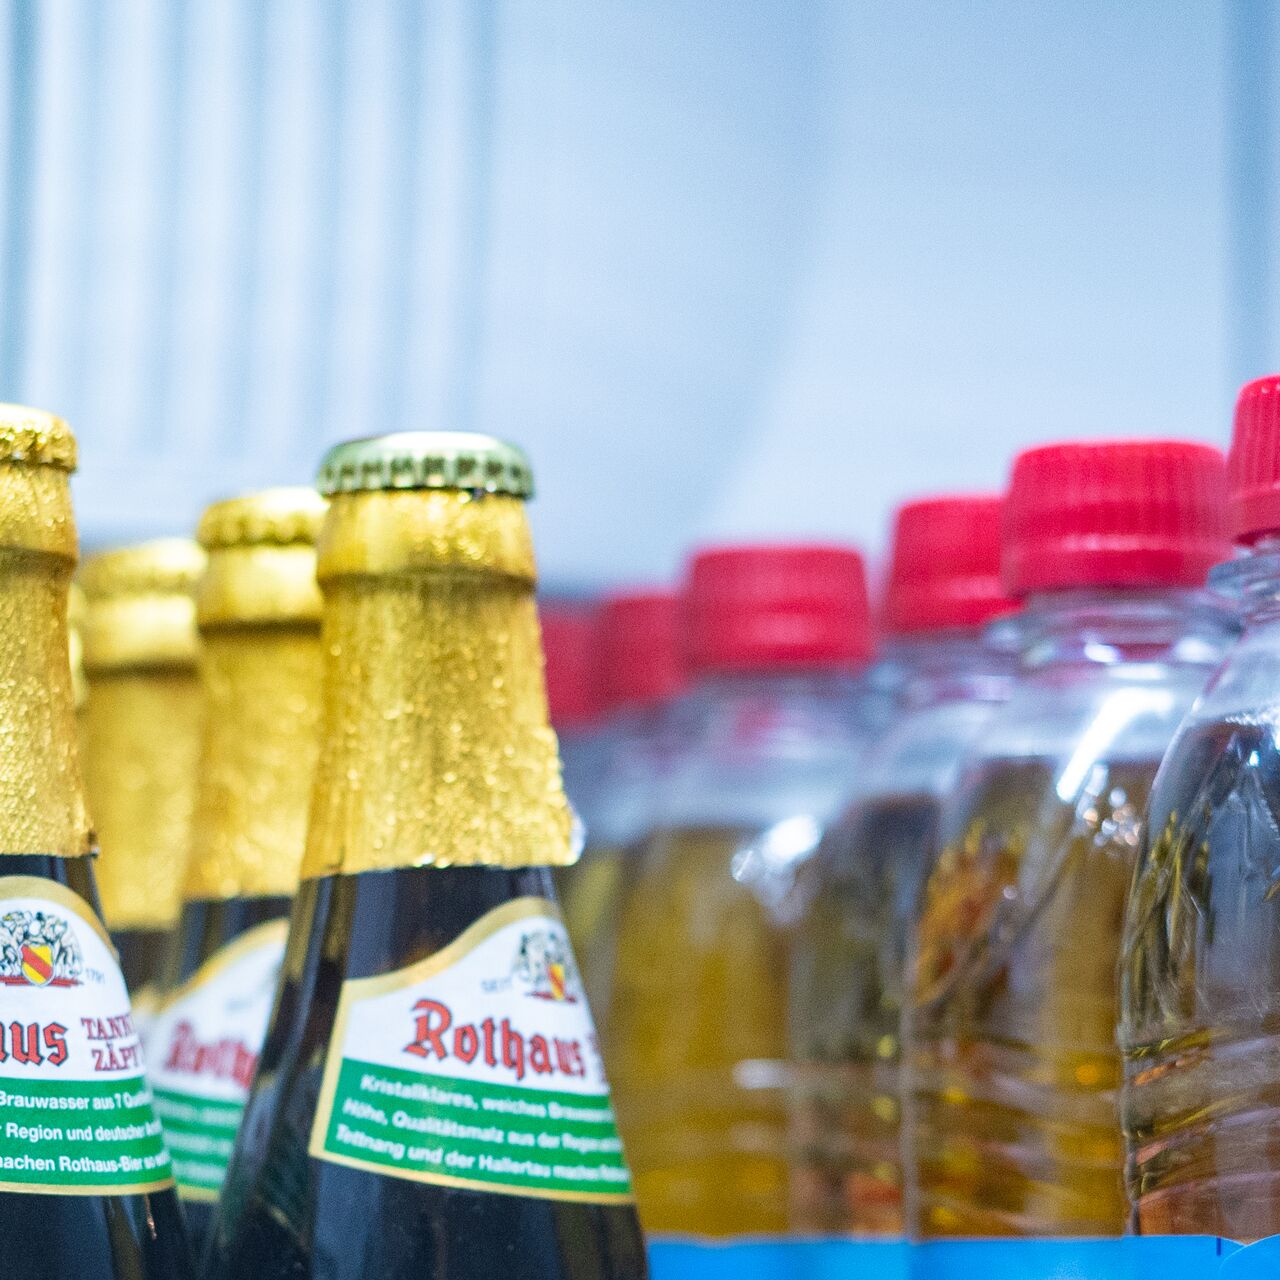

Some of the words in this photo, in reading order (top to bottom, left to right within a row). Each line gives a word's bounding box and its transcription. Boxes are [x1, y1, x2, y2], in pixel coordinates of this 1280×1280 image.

[402, 998, 586, 1081] Rothaus
[5, 1122, 63, 1143] Region
[66, 1125, 93, 1142] und
[59, 1155, 143, 1173] Rothaus-Bier
